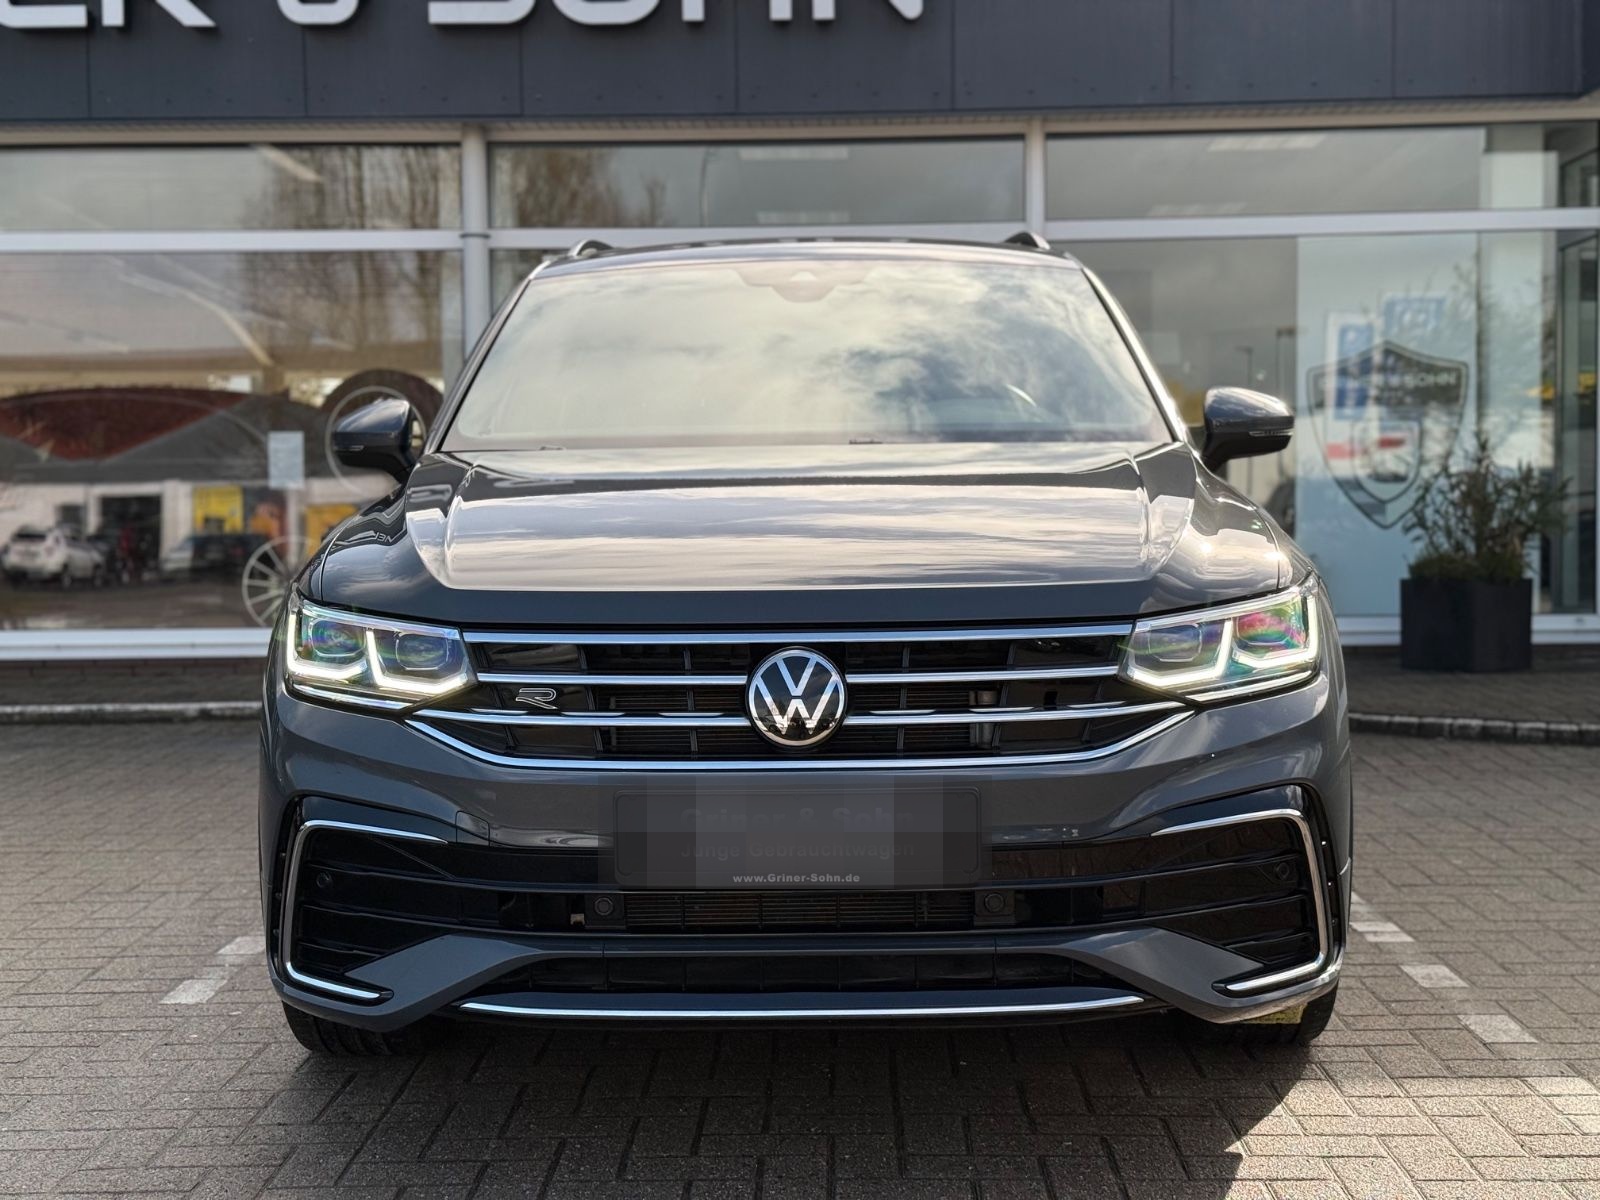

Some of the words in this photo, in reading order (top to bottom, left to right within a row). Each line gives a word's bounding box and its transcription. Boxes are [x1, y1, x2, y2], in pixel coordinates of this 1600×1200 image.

[680, 808, 785, 830] Griner
[832, 807, 915, 830] Sohn
[680, 841, 740, 861] Junge
[750, 840, 915, 860] Gebrauchtwagen
[733, 873, 861, 884] www.Griner-Sohn.de
